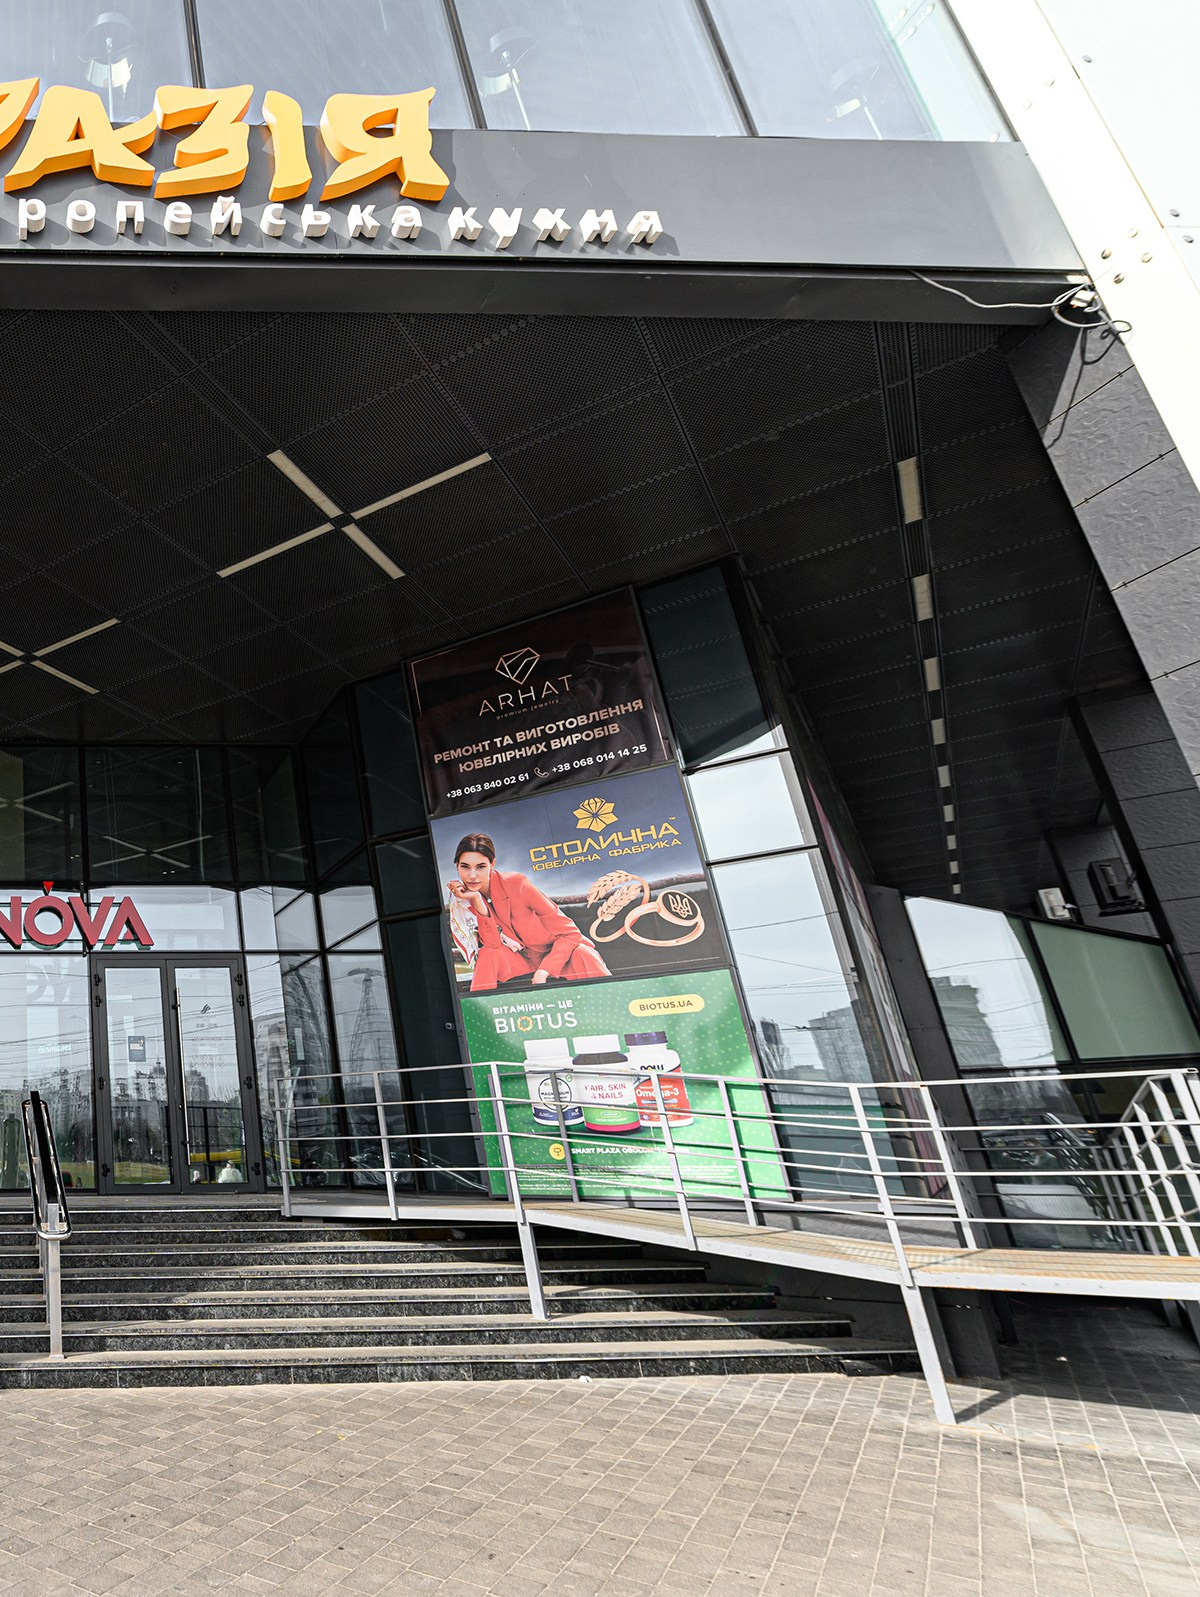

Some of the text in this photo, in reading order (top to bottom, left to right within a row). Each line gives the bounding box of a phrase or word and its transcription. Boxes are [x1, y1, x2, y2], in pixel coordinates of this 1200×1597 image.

[479, 674, 573, 717] ARHAT
[433, 698, 645, 764] РЕМОНТ ТА ВИГОТОВЛЕННЯ
[458, 723, 621, 773] ЮВЕЛІРНИХ ВИРОБІВ
[551, 743, 648, 774] +38 068 014 14 25
[446, 772, 530, 800] +38 063 840 02 61
[529, 821, 680, 864] СТОЛИЧНА
[532, 838, 682, 872] ЮВЕЛІРНА ФАБРИКА
[492, 1003, 544, 1015] ВІТАМІНИ
[558, 1000, 574, 1011] ЦЕ
[639, 1000, 694, 1012] BIOTUS.UA
[493, 1011, 578, 1034] BIOTUS
[598, 1091, 624, 1100] NAILS
[608, 1082, 627, 1091] SKIN
